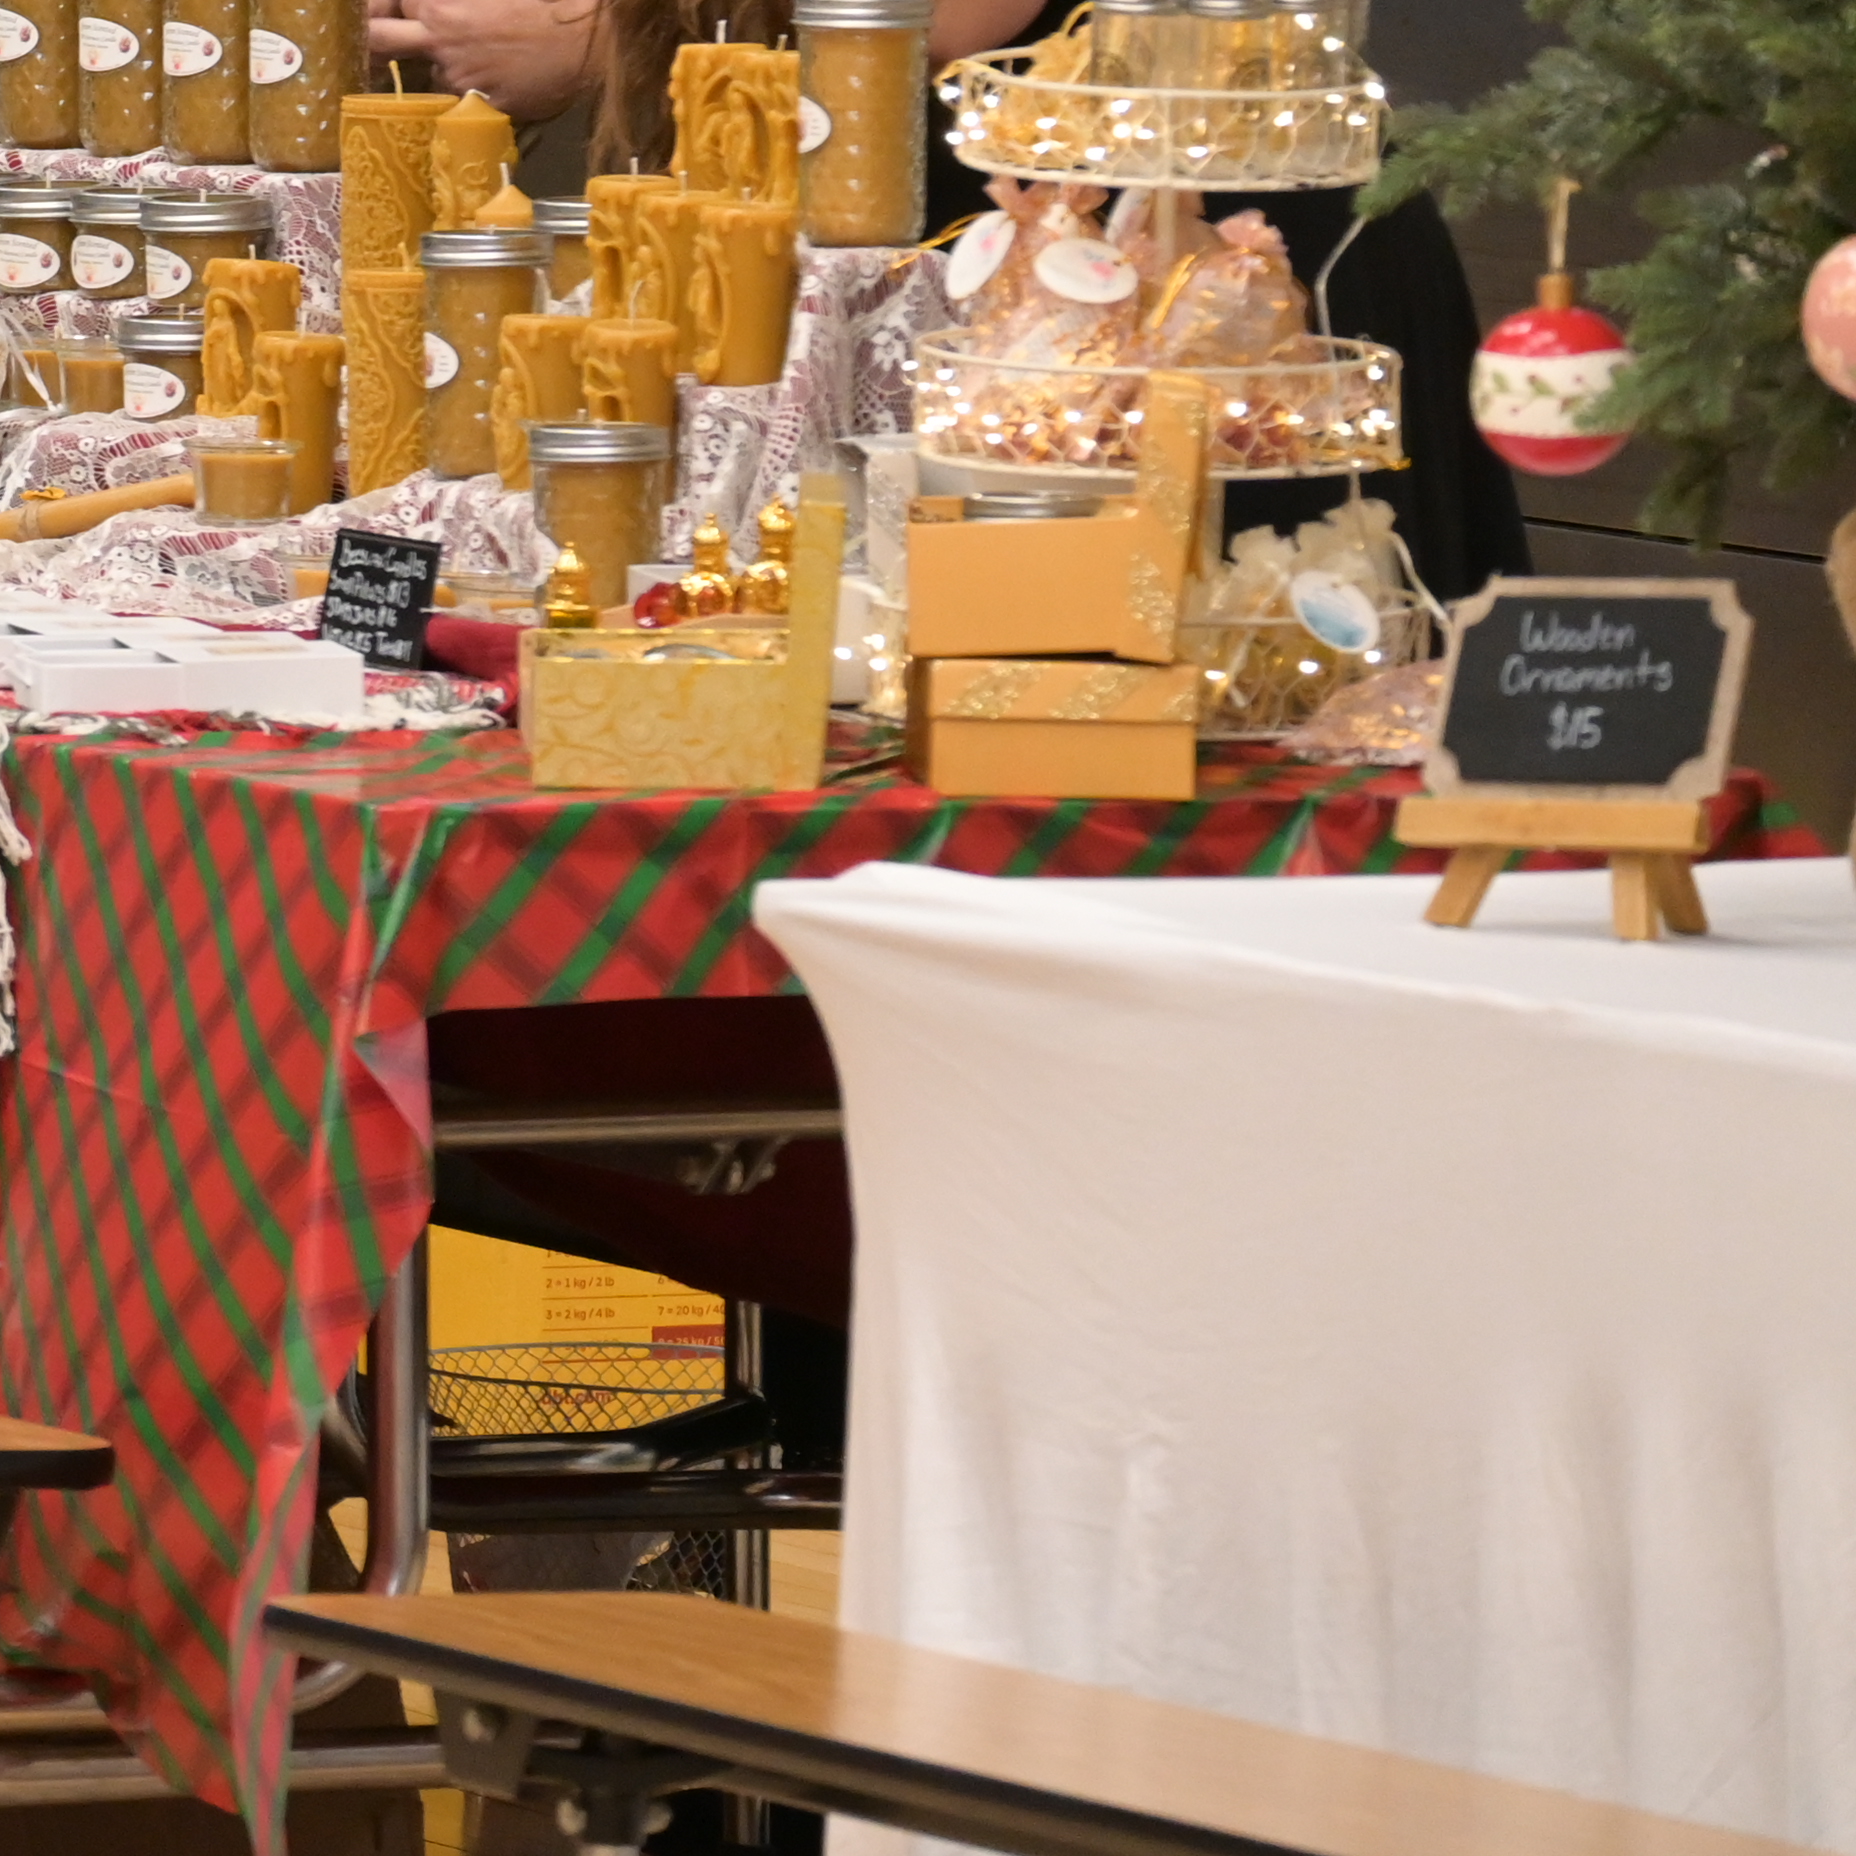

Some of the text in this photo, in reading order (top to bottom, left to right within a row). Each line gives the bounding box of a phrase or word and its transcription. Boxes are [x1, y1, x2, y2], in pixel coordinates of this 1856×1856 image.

[1519, 609, 1636, 653] Wooden
[1499, 646, 1674, 696] Ornaments
[1546, 700, 1605, 751] $15
[546, 1278, 553, 1289] 2
[565, 1278, 571, 1288] 1
[573, 1277, 587, 1290] kg
[596, 1277, 603, 1287] 2
[605, 1276, 615, 1287] lb
[546, 1309, 553, 1320] 3
[564, 1309, 572, 1319] 2
[573, 1308, 586, 1321] kg
[595, 1308, 603, 1318] 4
[605, 1308, 615, 1318] lb
[658, 1306, 665, 1316] 7
[676, 1305, 690, 1316] 20
[692, 1305, 704, 1317] kg
